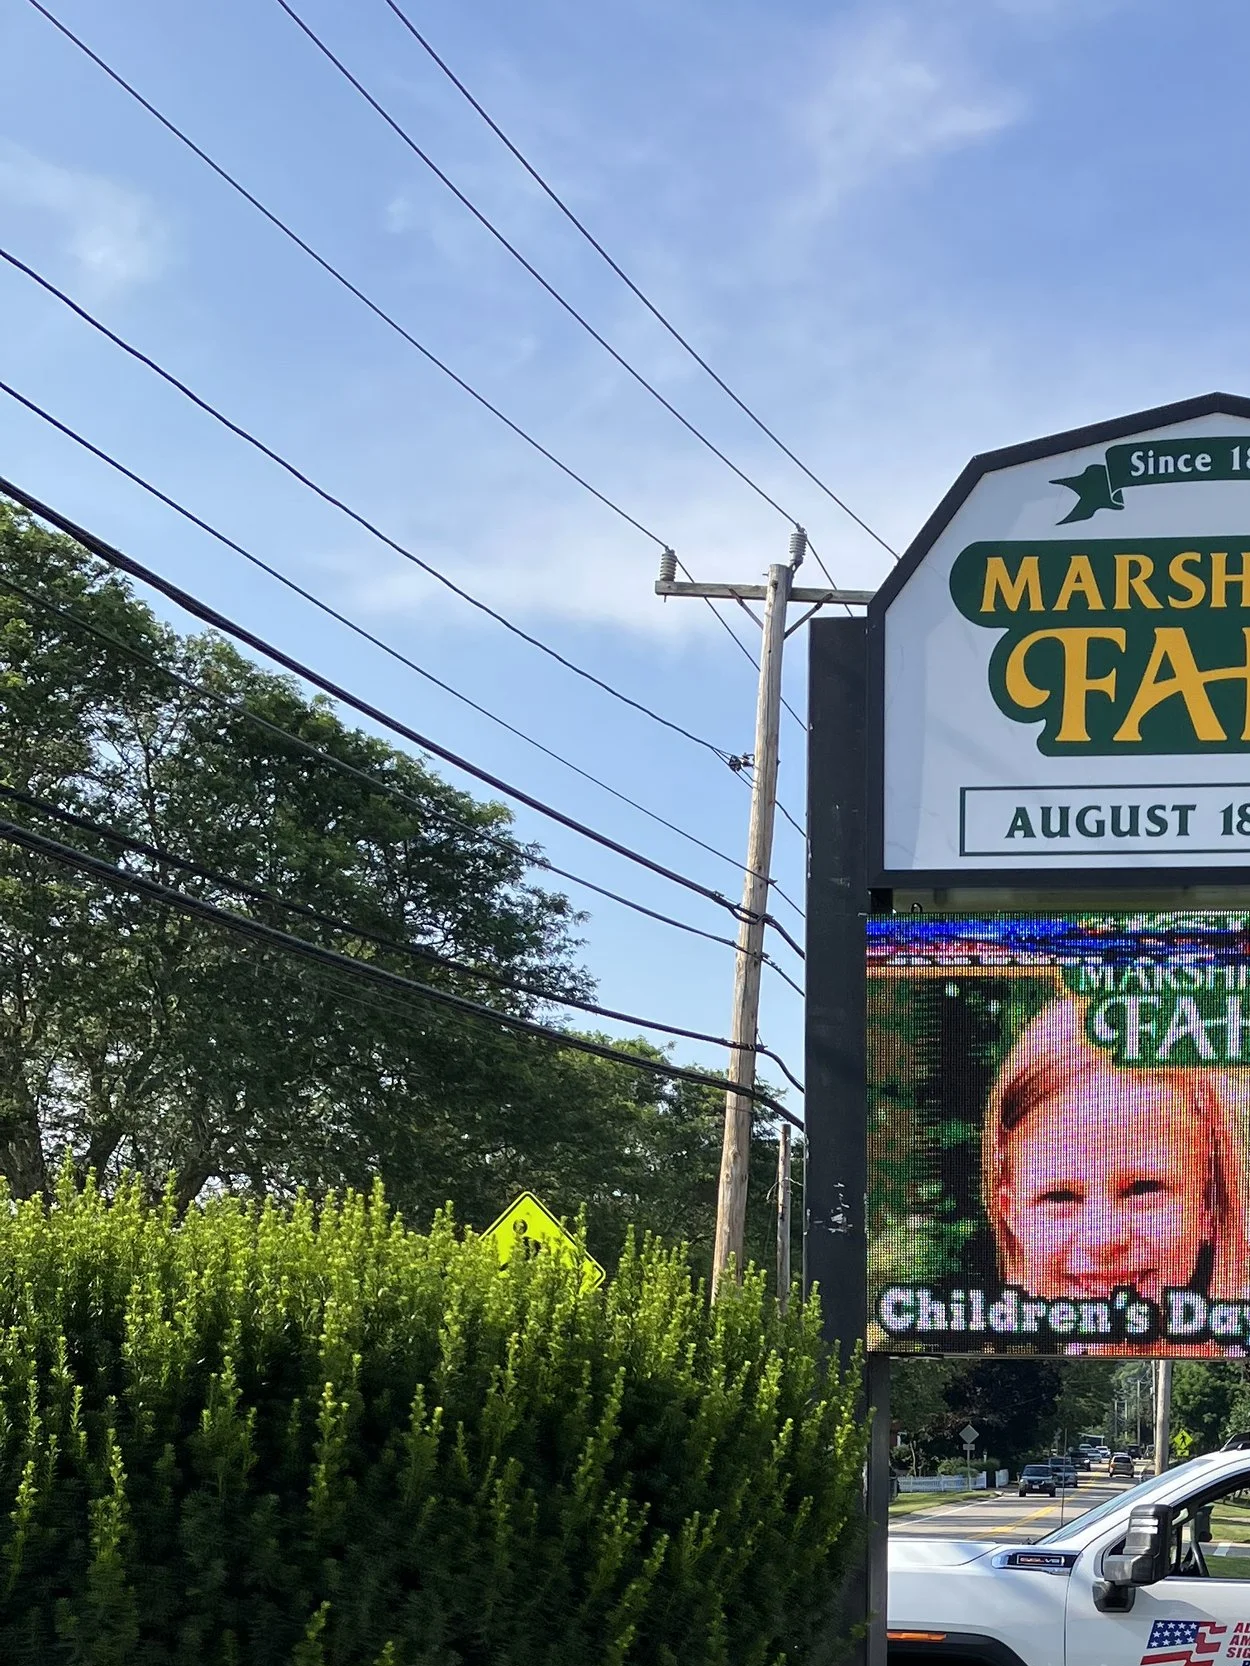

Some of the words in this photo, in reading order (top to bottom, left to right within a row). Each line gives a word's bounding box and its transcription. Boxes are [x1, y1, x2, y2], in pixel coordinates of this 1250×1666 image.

[1130, 448, 1212, 478] Since
[1004, 803, 1197, 840] AUGUST
[879, 1287, 1151, 1336] Children's
